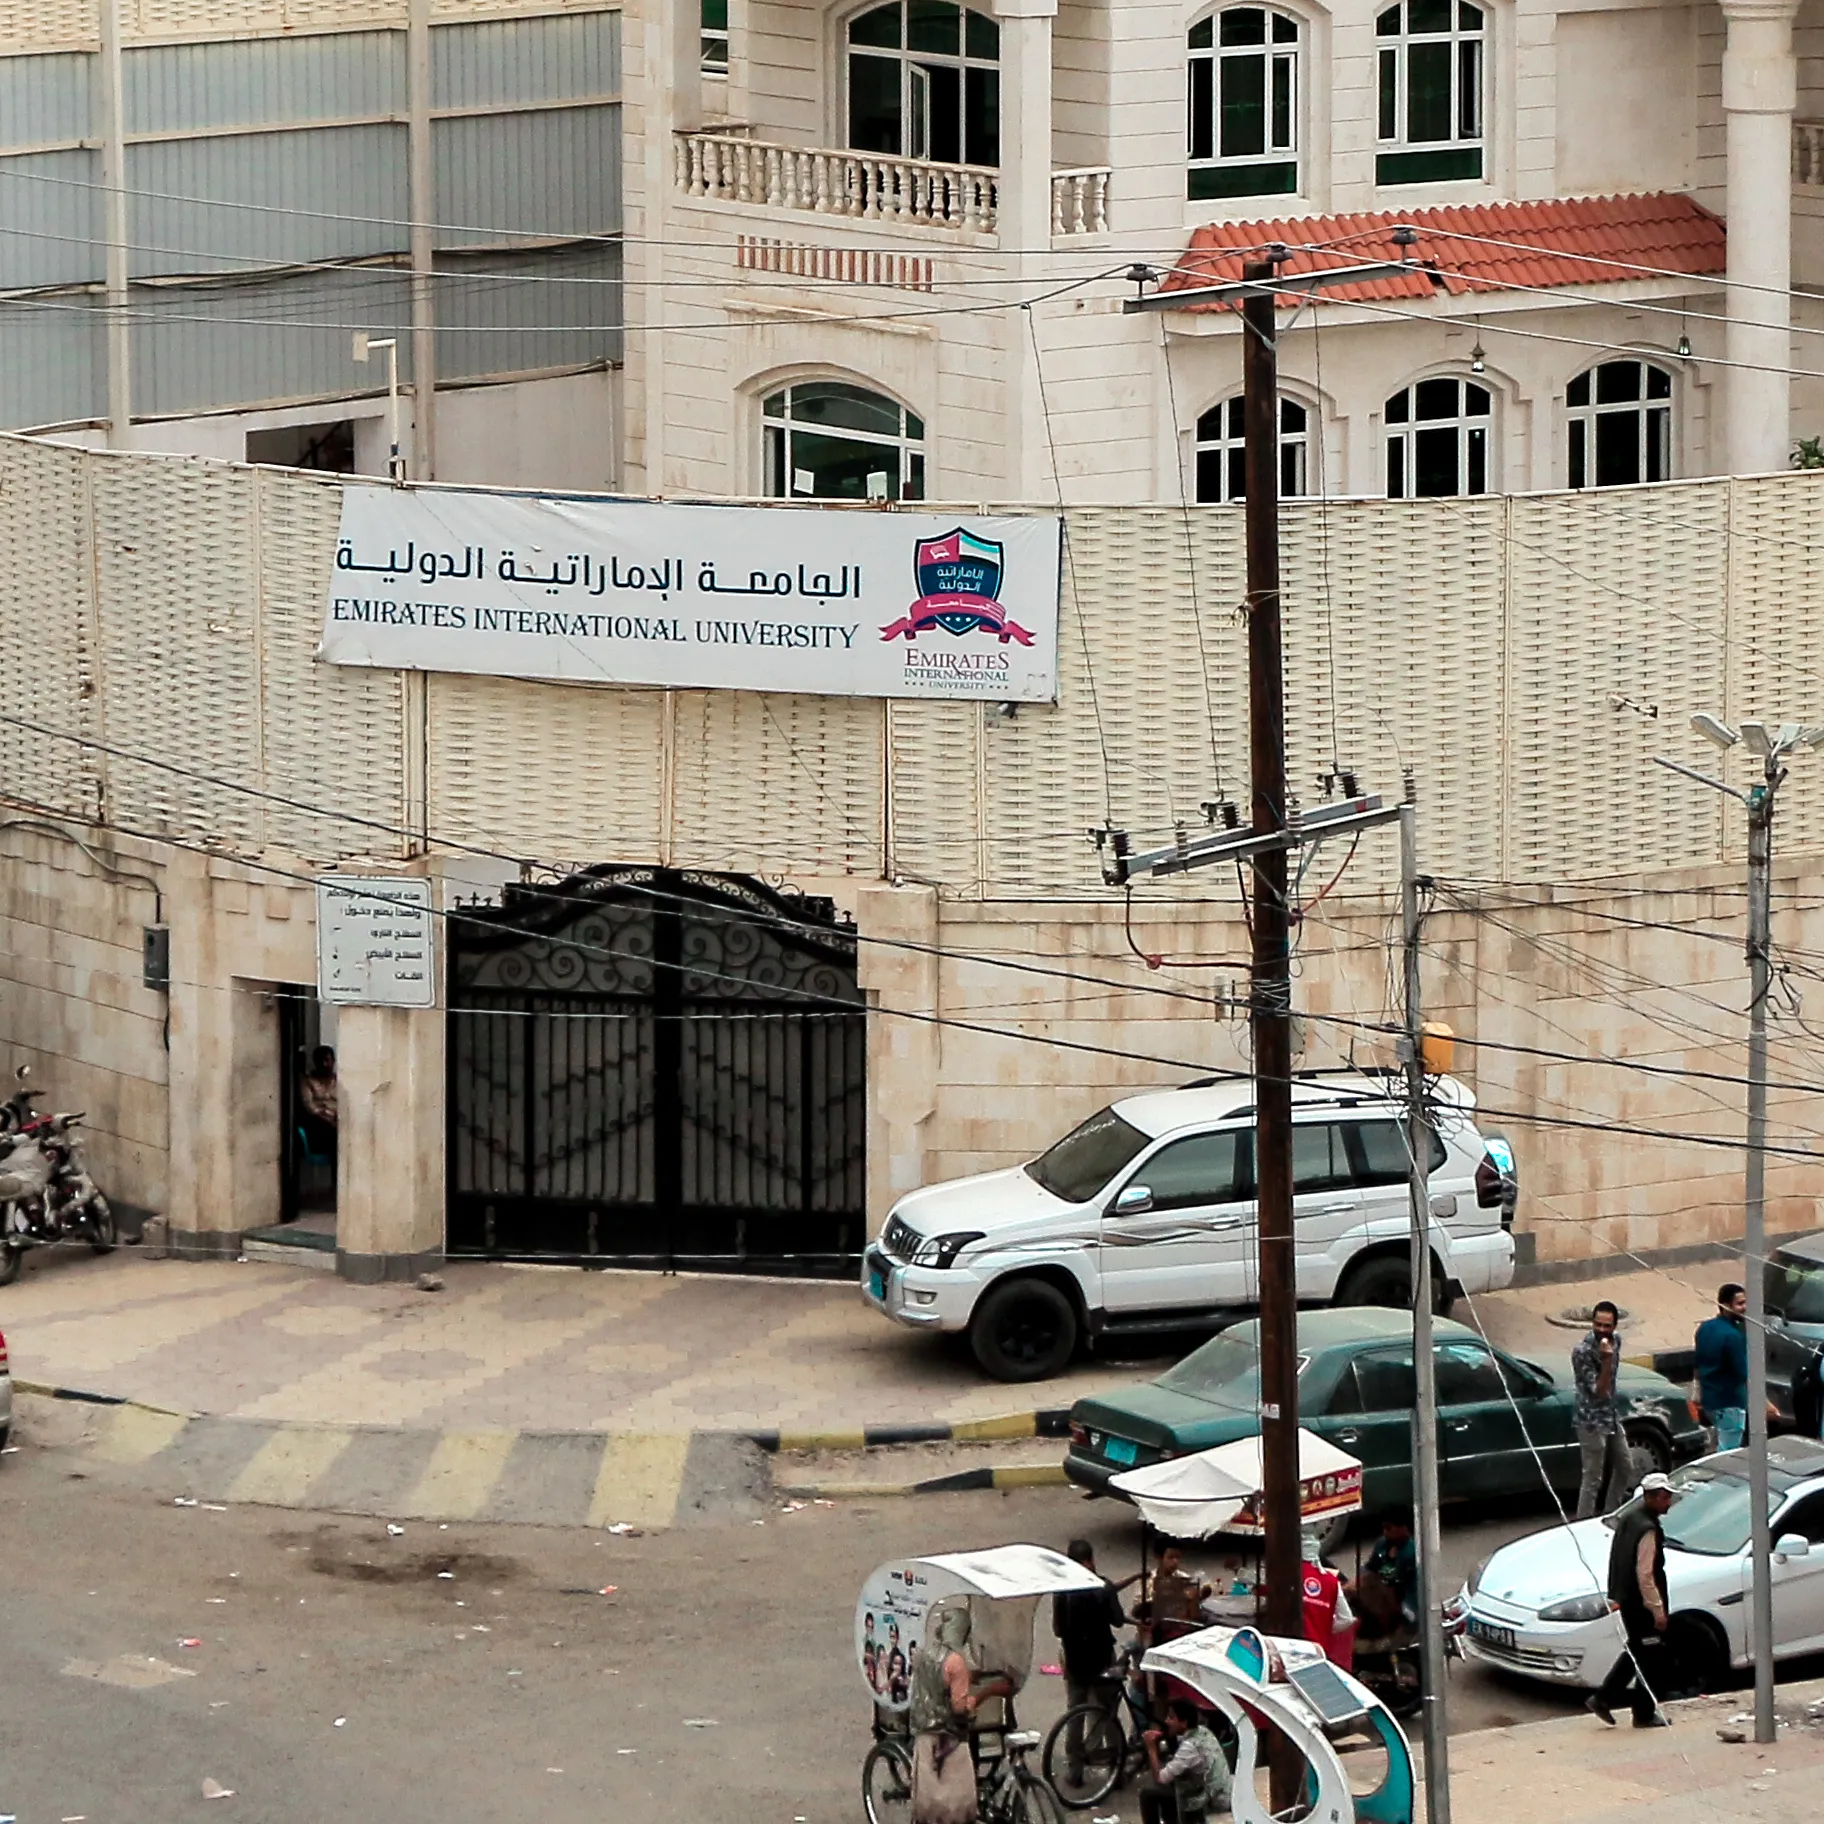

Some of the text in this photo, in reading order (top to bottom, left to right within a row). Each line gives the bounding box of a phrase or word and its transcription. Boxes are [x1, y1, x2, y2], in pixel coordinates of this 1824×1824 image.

[336, 538, 861, 606] الجامعة الإماراتية الدولية
[332, 599, 861, 649] EMIRATES INTERNATIONAL UNIVERSITY
[904, 648, 1009, 672] EMIRATES
[904, 668, 1009, 682] INTERNATIONAL
[928, 681, 986, 690] UNIVERSITY
